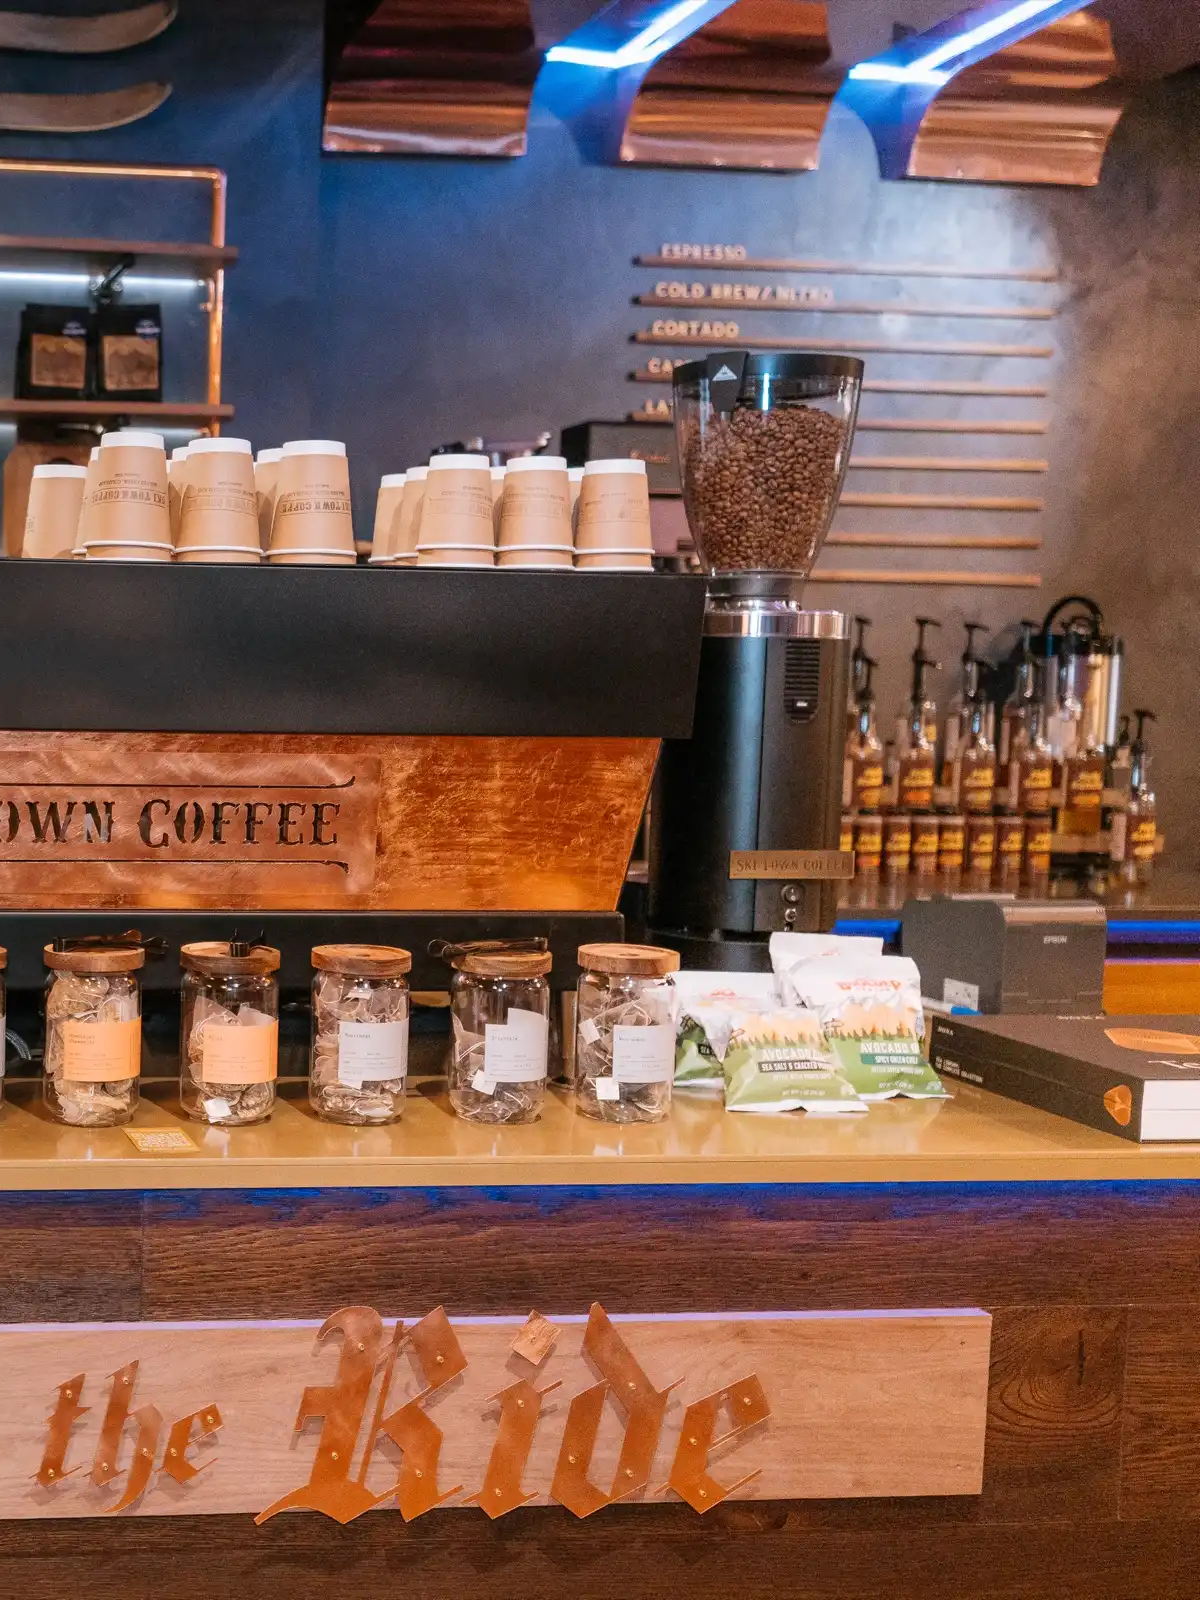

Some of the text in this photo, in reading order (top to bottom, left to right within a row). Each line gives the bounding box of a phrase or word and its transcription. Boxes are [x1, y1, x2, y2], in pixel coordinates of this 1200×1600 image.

[655, 281, 705, 299] COLD
[652, 319, 740, 338] CORTADO
[136, 798, 341, 849] COFFEE
[763, 1047, 810, 1060] AVOCADO
[860, 1042, 909, 1053] AVOCADO
[761, 1063, 773, 1071] SEA
[774, 1062, 787, 1071] SALT
[29, 1359, 224, 1513] the
[253, 1302, 774, 1525] Ride
